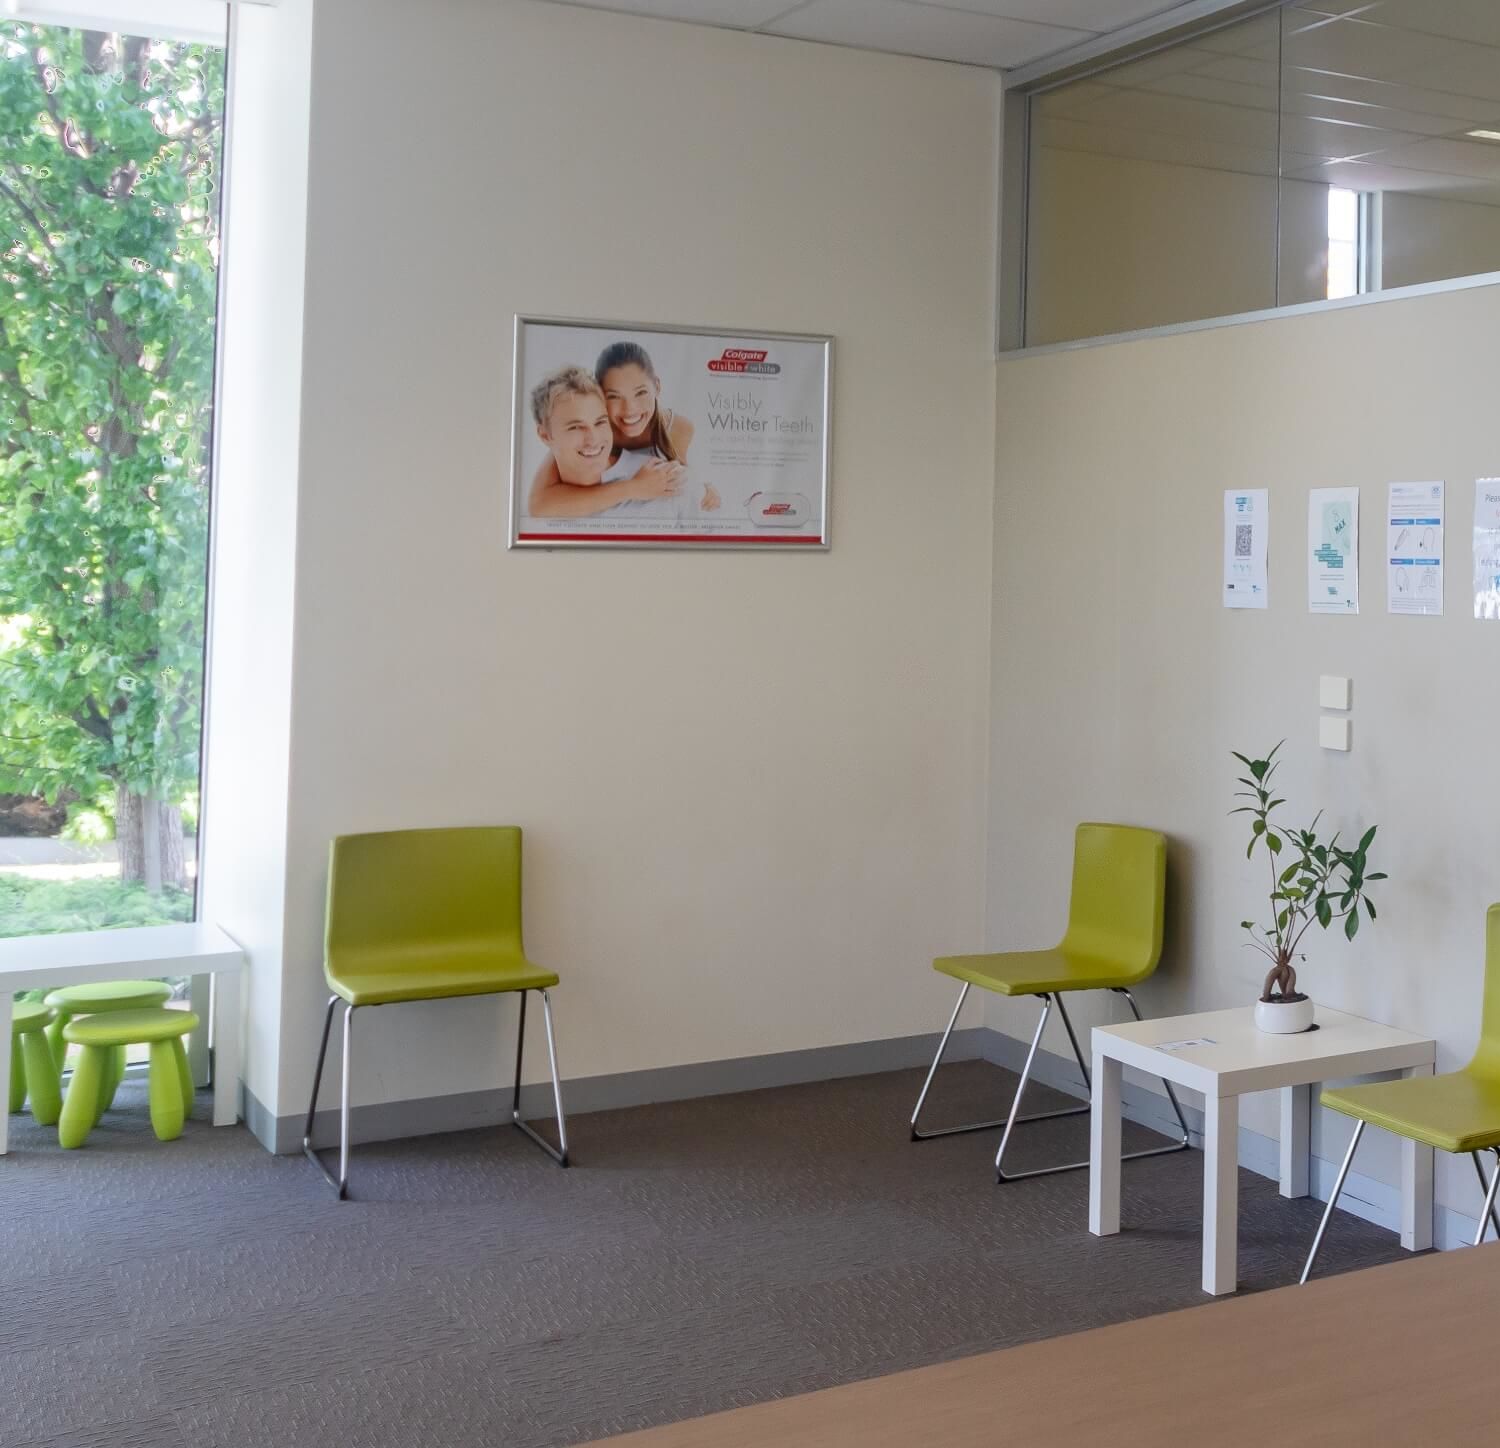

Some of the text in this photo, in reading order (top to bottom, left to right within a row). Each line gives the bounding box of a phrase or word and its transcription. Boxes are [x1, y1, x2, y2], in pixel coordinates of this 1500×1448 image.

[725, 350, 764, 360] Colgate
[711, 361, 777, 374] visible white
[708, 392, 762, 416] Visibly
[708, 412, 814, 433] Whiter Teeth
